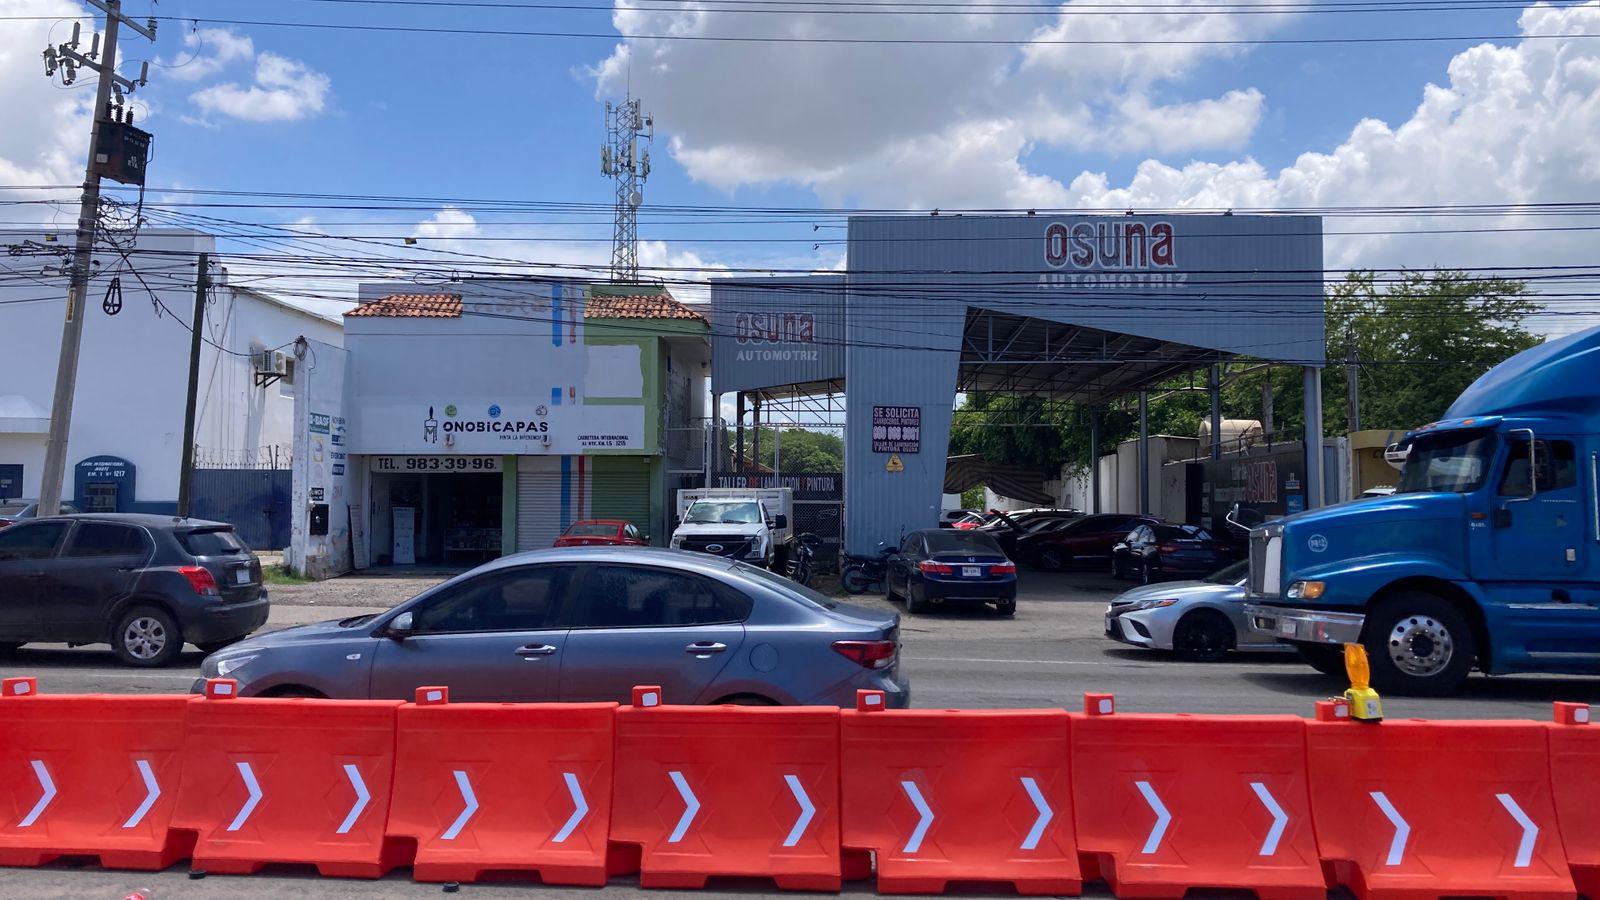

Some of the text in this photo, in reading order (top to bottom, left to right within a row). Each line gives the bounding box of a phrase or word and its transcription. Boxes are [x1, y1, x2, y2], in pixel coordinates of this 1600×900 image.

[1044, 222, 1177, 270] osuna
[1037, 273, 1188, 289] AUTOMOTRIZ
[735, 312, 817, 345] osuna
[736, 350, 818, 361] AUTOMOTRIZ
[874, 408, 919, 418] SE SOLICITA
[378, 458, 399, 469] TEL.
[718, 476, 747, 488] TALLER
[806, 476, 835, 492] PINTURA
